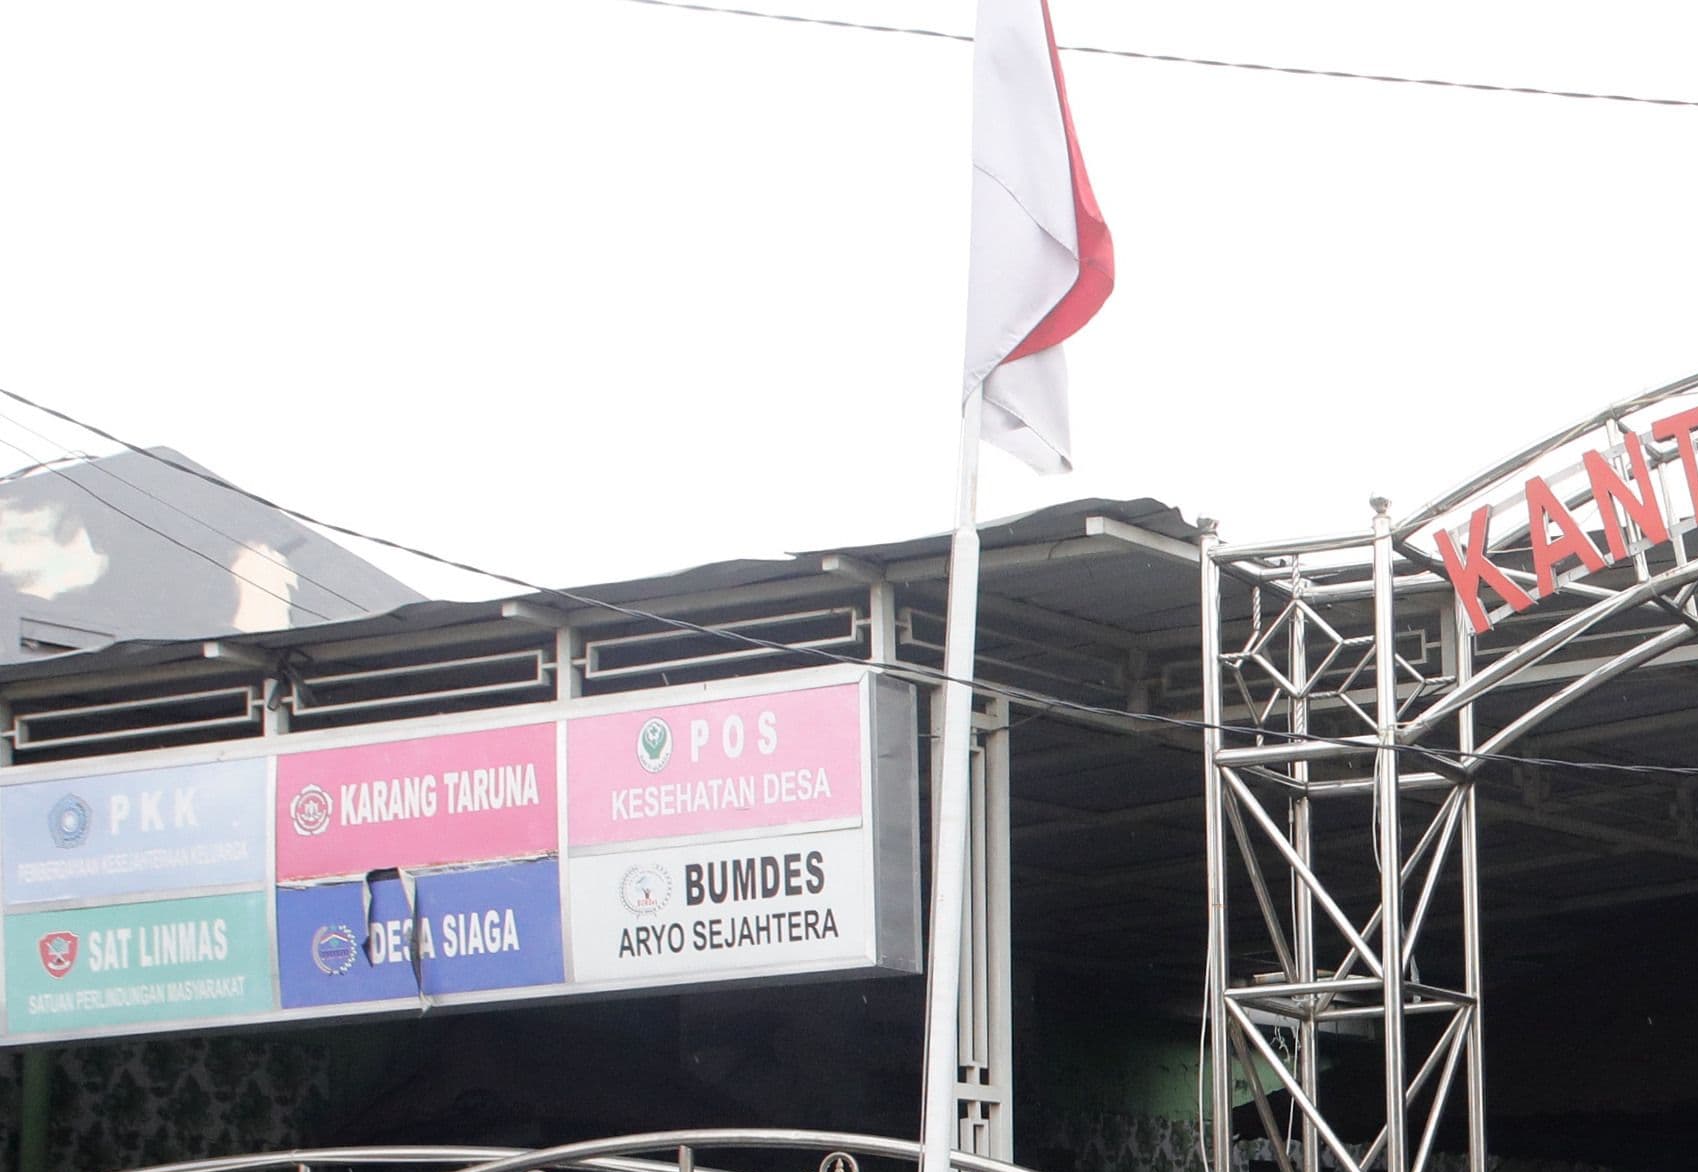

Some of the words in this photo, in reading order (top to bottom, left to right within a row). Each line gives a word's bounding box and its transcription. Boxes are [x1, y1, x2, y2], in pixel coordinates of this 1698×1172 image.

[340, 775, 437, 826] KARANG
[443, 763, 539, 814] TARUNA
[611, 775, 756, 821] KESEHATAN
[763, 767, 832, 804] DESA
[685, 850, 825, 907] BUMDES
[88, 928, 132, 972] SAT
[139, 918, 228, 968] LINMAS
[442, 908, 520, 958] SIAGA
[618, 922, 684, 958] ARYO
[692, 908, 839, 951] SEJAHTERA
[28, 993, 74, 1015] SATUAN
[76, 983, 165, 1011] PERLINDUNGAN
[167, 976, 246, 1003] MASYARAKAT
